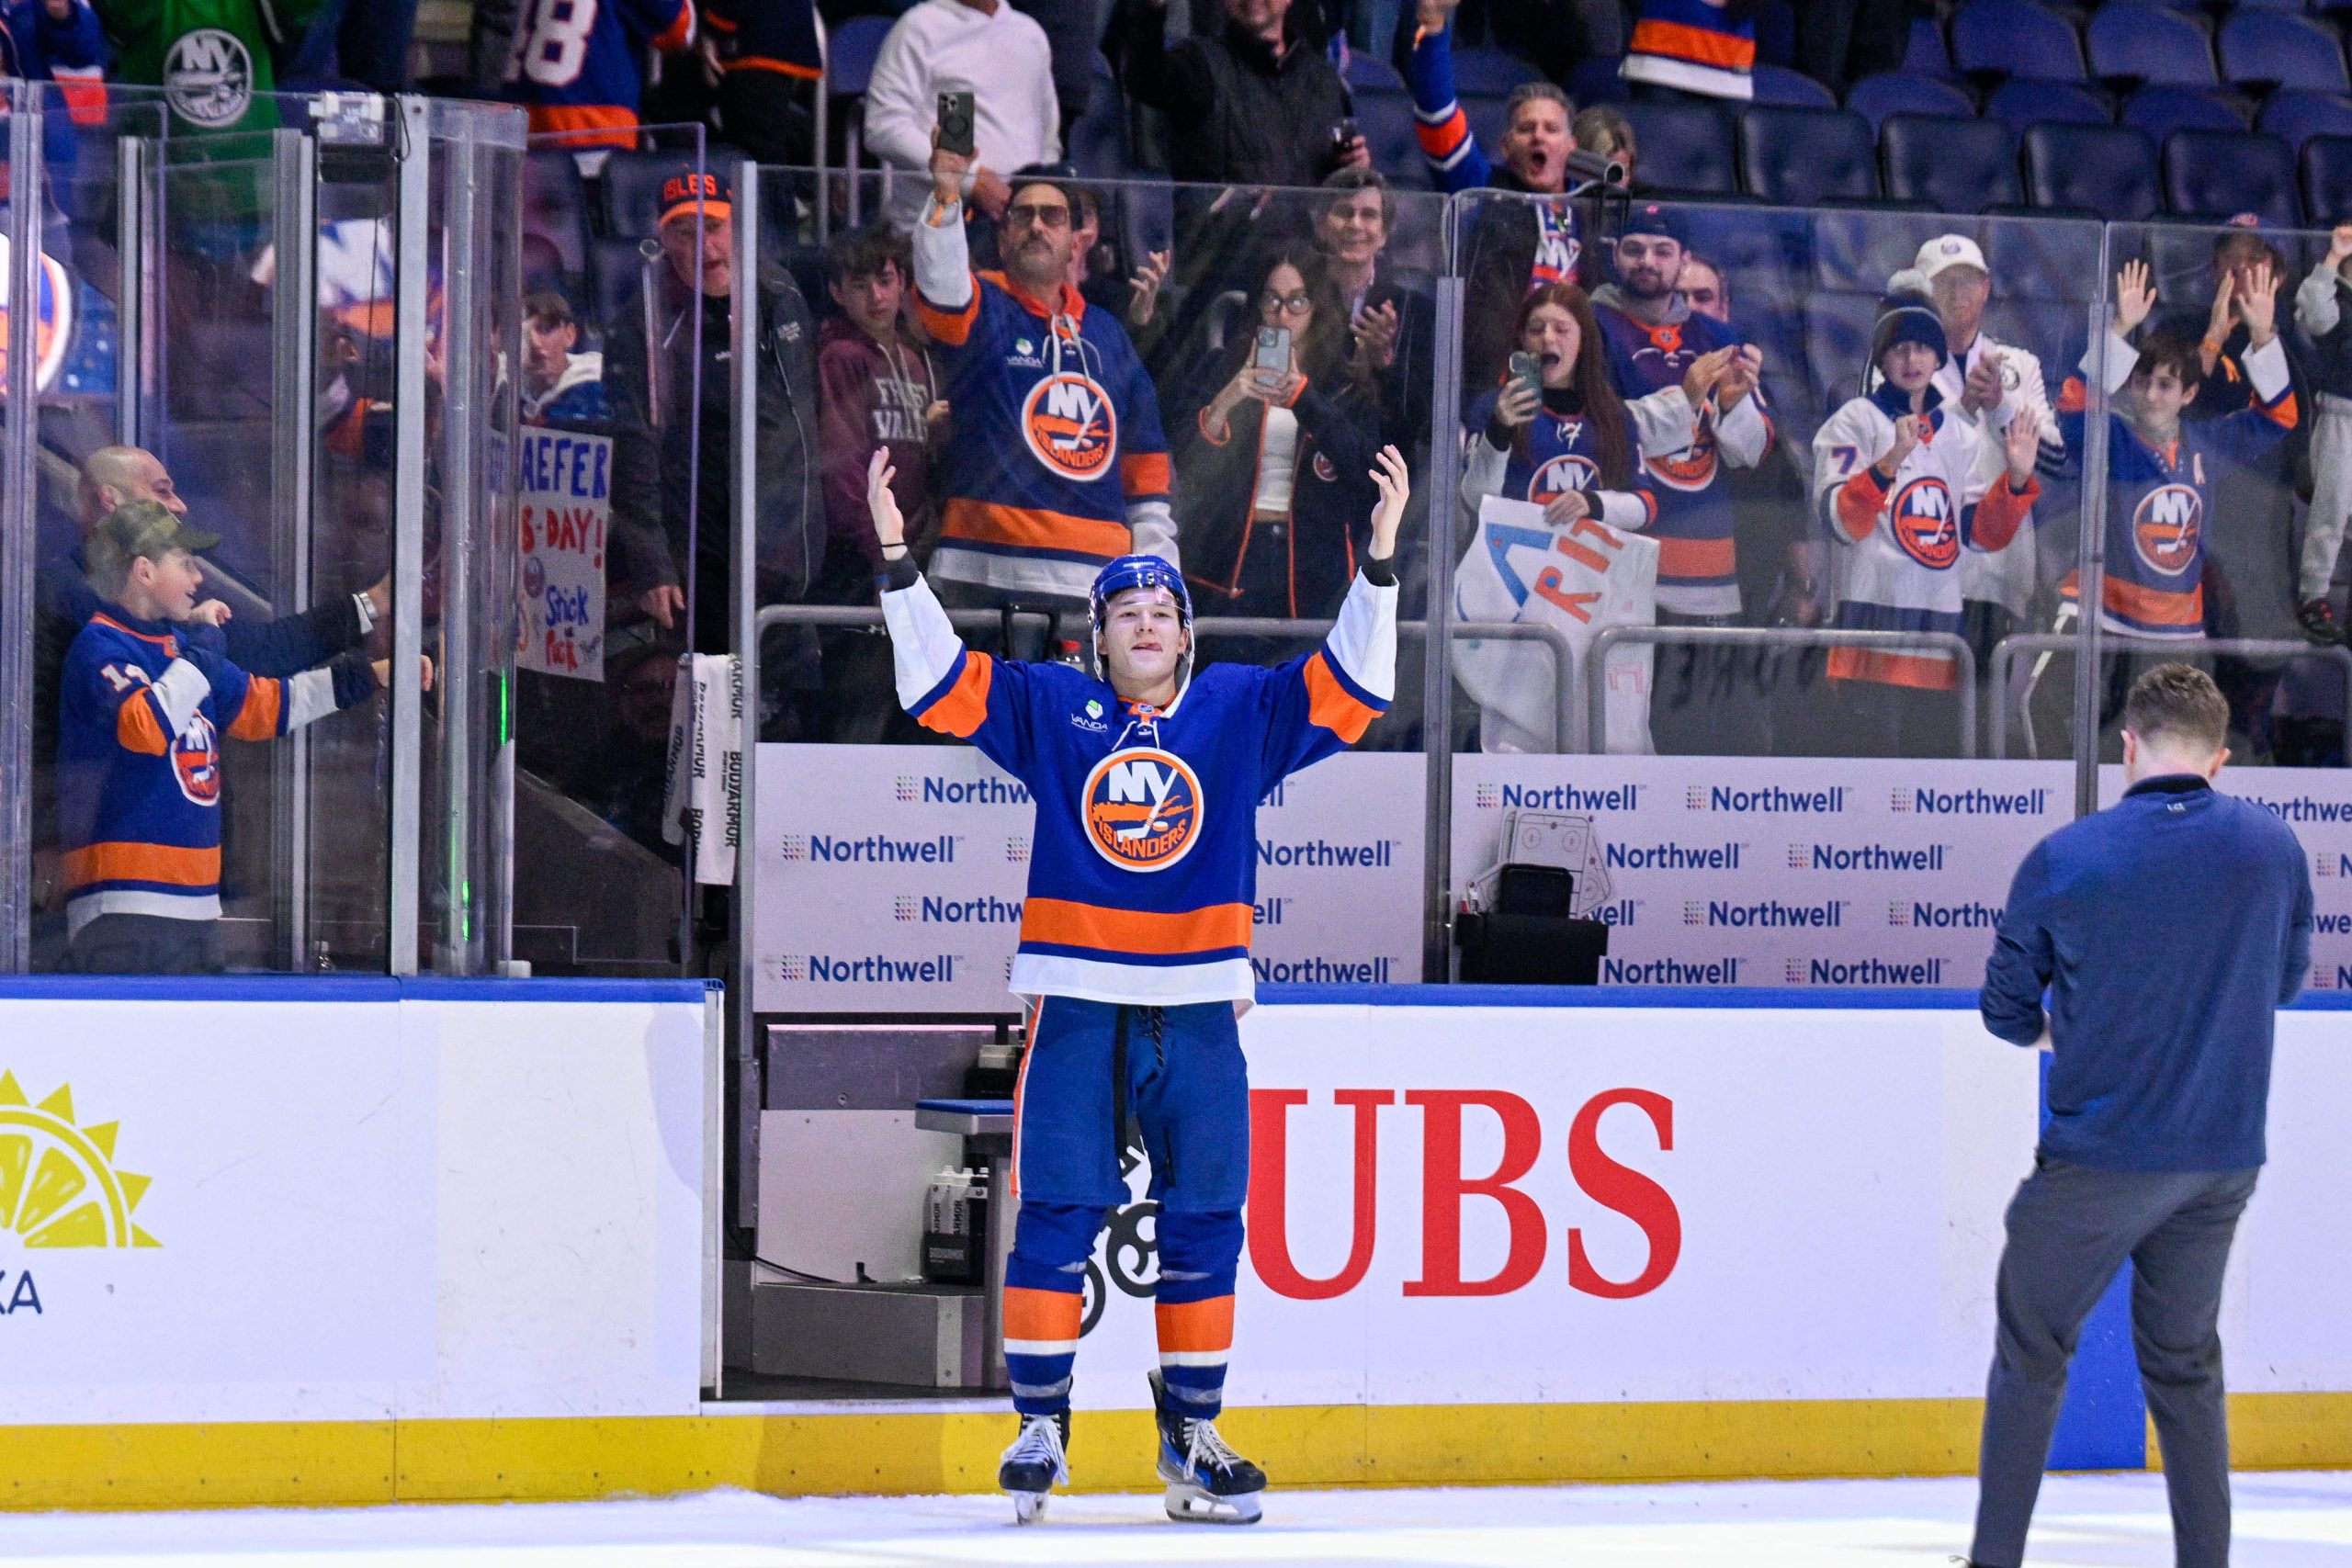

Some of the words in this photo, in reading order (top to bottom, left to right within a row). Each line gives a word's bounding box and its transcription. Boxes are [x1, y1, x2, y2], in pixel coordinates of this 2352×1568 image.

[1047, 381, 1102, 424] NY
[520, 435, 609, 500] AEFER
[1831, 445, 1858, 475] 7
[1070, 713, 1109, 730] VANDA
[923, 776, 1030, 804] Northw
[1109, 761, 1180, 806] NY
[1502, 784, 1637, 811] Northwell
[1712, 785, 1843, 812] Northwell
[1916, 788, 2044, 815] Northwell
[810, 835, 954, 863] Northwell
[1098, 818, 1187, 858] ISLANDERS
[1256, 840, 1390, 866] Northwell
[1607, 842, 1739, 869] Northwell
[1813, 844, 1942, 870] Northwell
[922, 896, 1023, 923] Northw
[1709, 900, 1840, 927] Northwell
[808, 954, 952, 982] Northwell
[1253, 957, 1388, 984] Northwell
[1604, 958, 1736, 984] Northwell
[1810, 958, 1940, 984] Northwell
[1247, 1088, 1681, 1301] UBS
[953, 1200, 963, 1235] ARMOR
